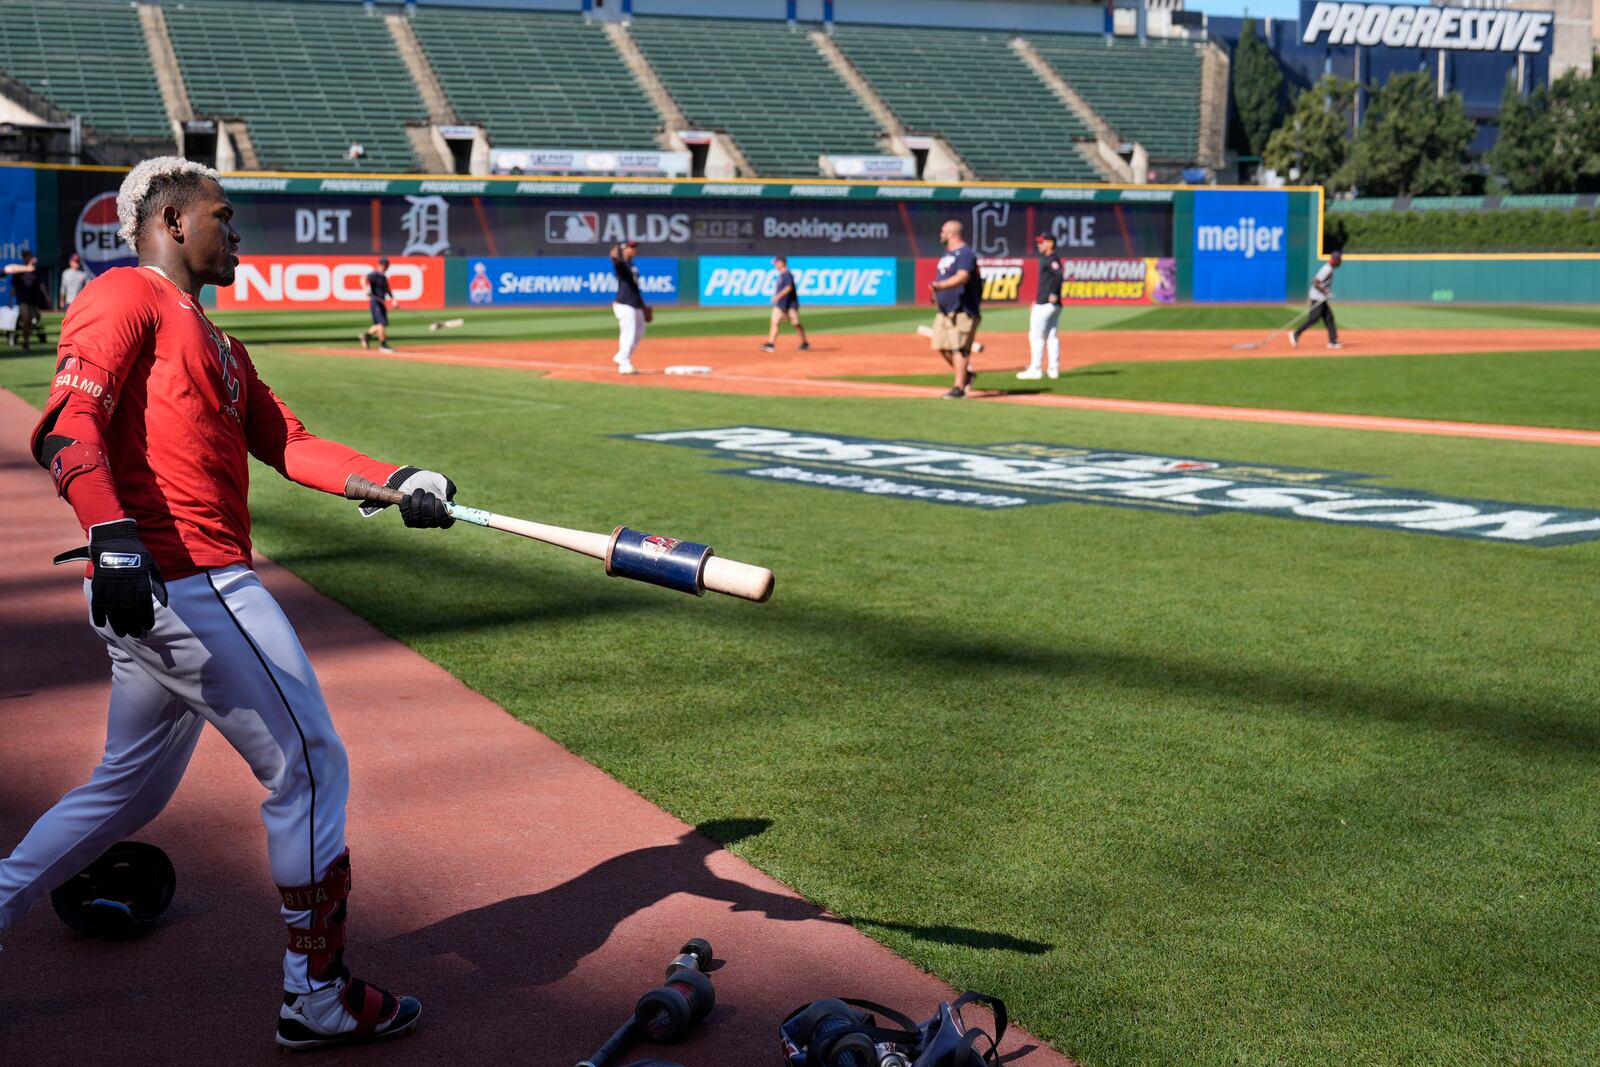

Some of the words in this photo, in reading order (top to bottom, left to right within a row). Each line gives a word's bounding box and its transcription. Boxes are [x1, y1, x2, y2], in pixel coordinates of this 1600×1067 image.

[1302, 2, 1553, 53] PROGRESSIVE
[295, 208, 352, 243] DET
[602, 213, 691, 243] ALDS
[694, 220, 755, 237] 2024
[763, 216, 889, 242] Booking.com
[1052, 215, 1096, 247] CLE
[1197, 217, 1283, 259] meijer
[234, 263, 425, 301] NOCO
[1063, 260, 1145, 280] PHANTOM
[1061, 280, 1145, 299] FIREWORKS
[54, 373, 103, 398] SALMO
[633, 426, 1600, 541] POSTSEASON
[296, 935, 328, 950] 25:3
